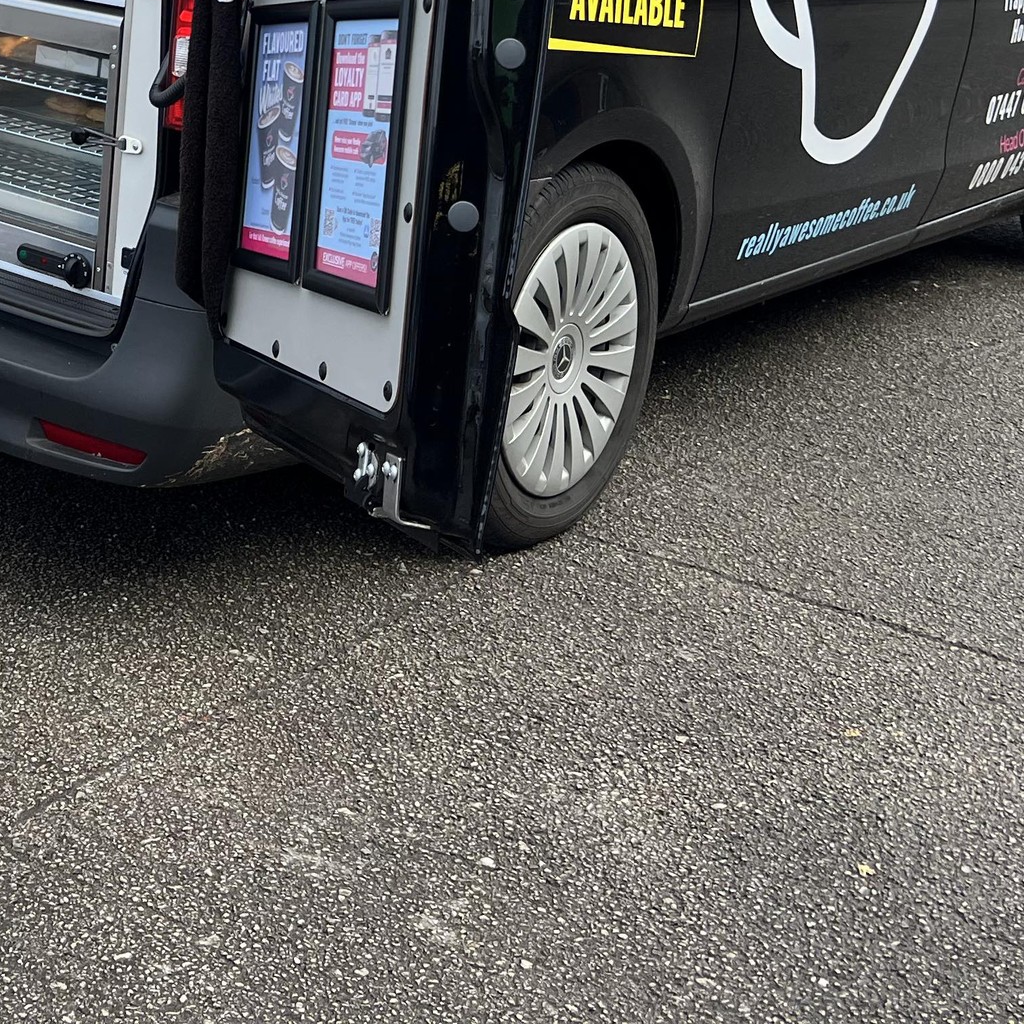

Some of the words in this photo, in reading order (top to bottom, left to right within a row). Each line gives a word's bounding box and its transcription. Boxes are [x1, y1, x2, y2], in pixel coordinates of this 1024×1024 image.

[262, 29, 305, 55] FLAVOURED
[262, 58, 281, 83] FLAT
[334, 66, 365, 88] LOYALTY
[333, 90, 349, 108] CARD
[348, 91, 363, 108] APP
[984, 89, 1023, 126] 07447
[999, 131, 1018, 155] Head
[968, 156, 1006, 191] 0800
[736, 183, 917, 261] reallyawesomecoffee.co.uk
